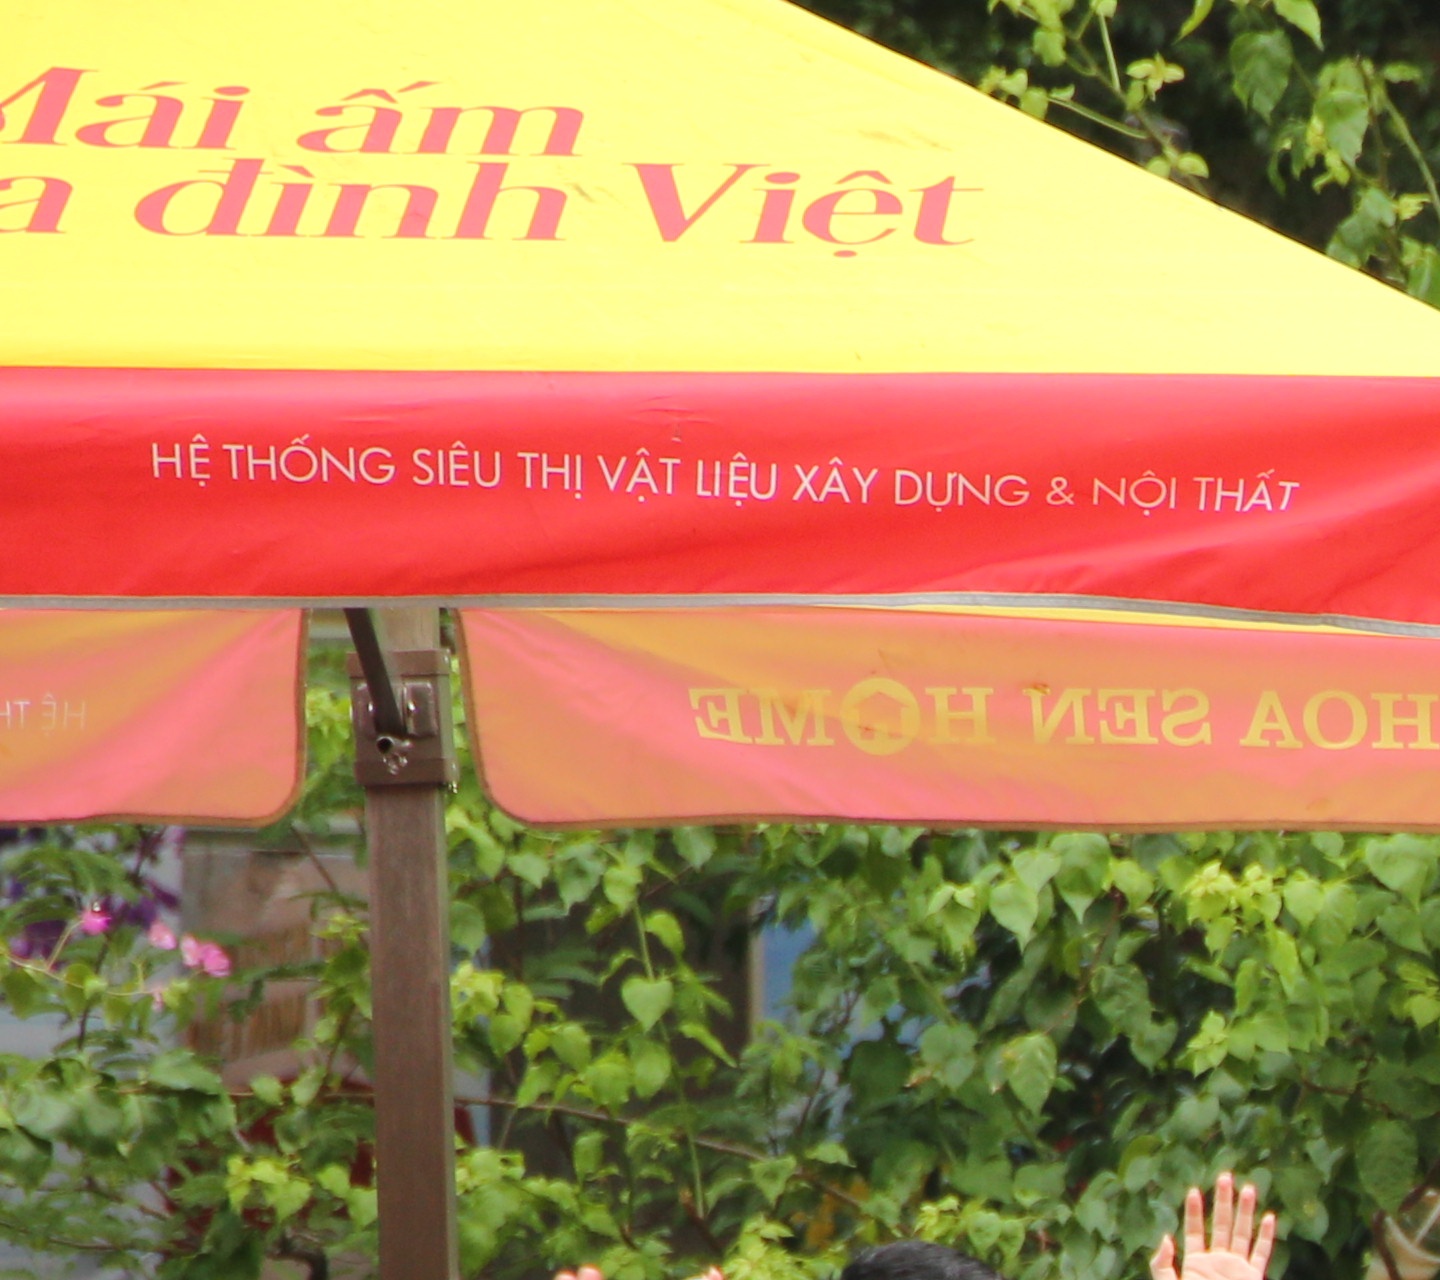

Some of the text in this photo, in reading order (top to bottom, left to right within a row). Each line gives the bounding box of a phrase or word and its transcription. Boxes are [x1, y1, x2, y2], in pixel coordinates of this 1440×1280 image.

[296, 81, 584, 156] ấm
[134, 158, 568, 240] đình
[623, 163, 984, 258] Việt
[152, 433, 1300, 516] HỆ THỐNG SIÊU THỊ VẬT LIỆU XÂY DỰNG & NỘI THẤT
